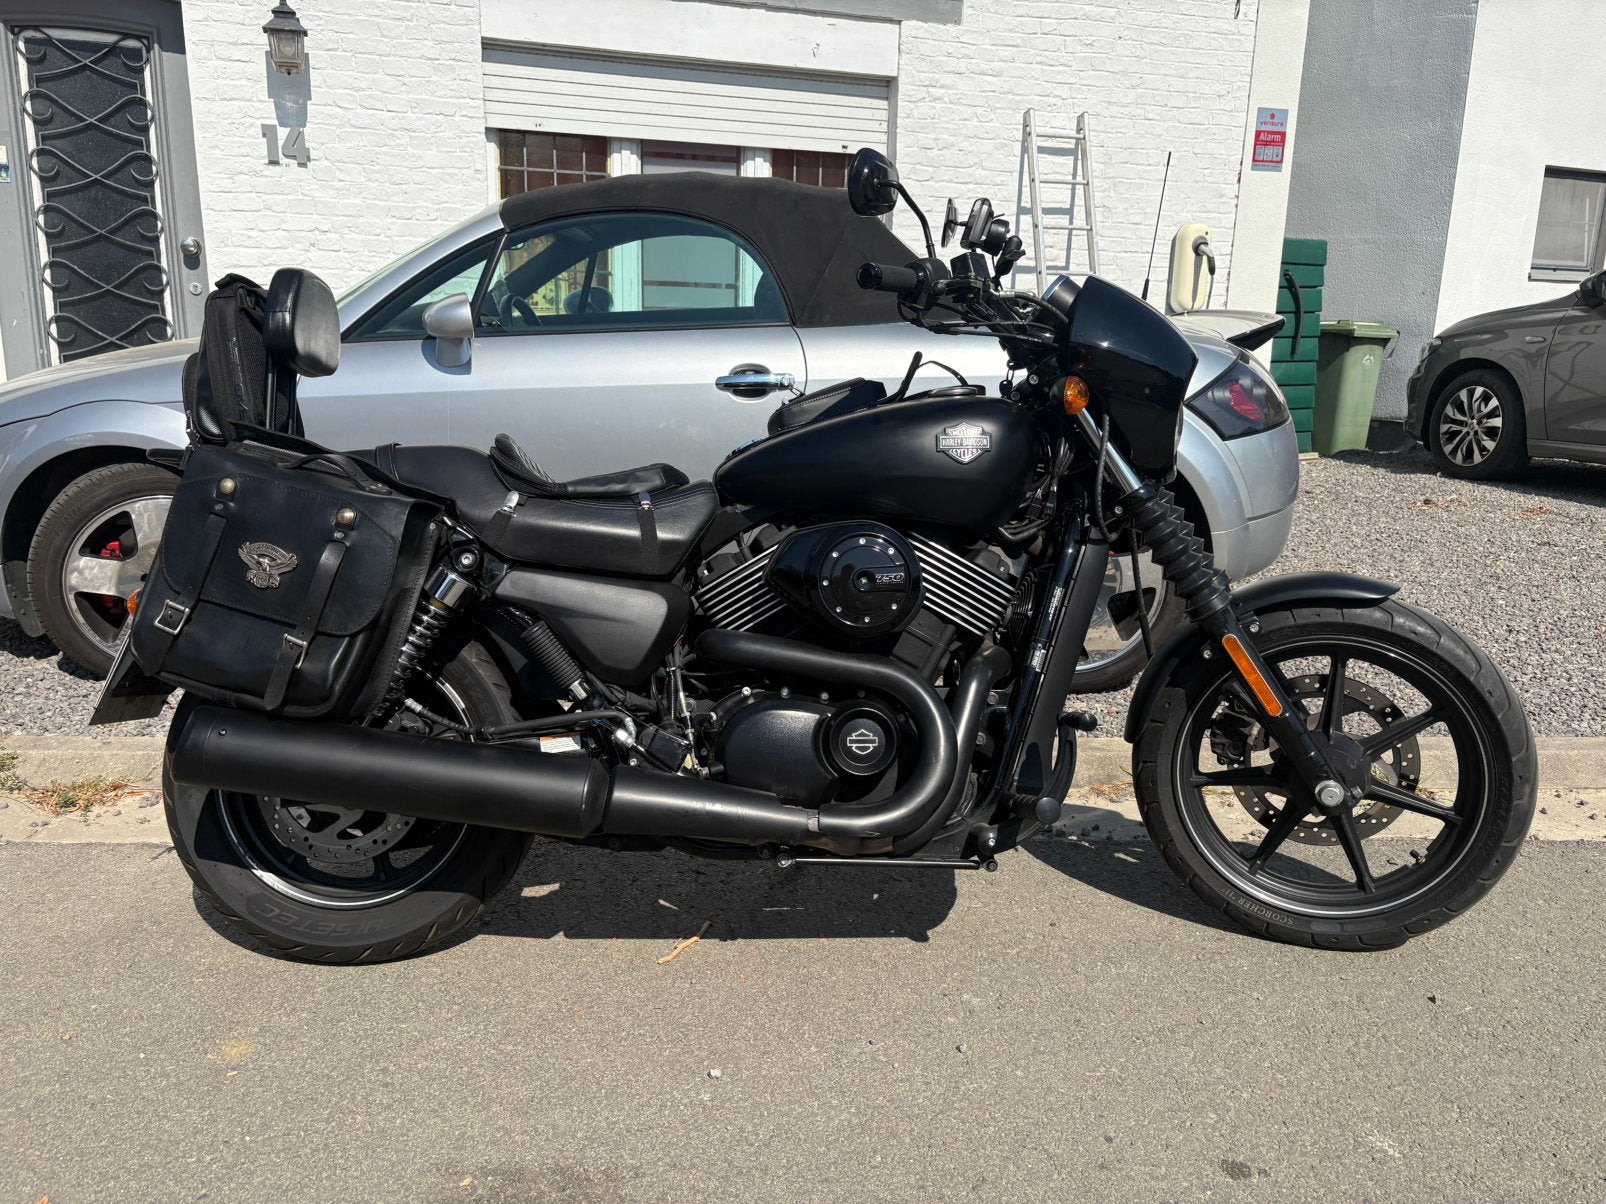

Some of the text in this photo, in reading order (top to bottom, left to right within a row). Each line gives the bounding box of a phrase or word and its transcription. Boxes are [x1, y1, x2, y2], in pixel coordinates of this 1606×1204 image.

[1259, 131, 1281, 142] Alarm
[261, 124, 311, 167] 14
[942, 437, 988, 447] HARLEY-DAVIDSON
[952, 448, 978, 459] CYCLES
[875, 573, 904, 583] 750
[1238, 896, 1294, 925] SCORCHER
